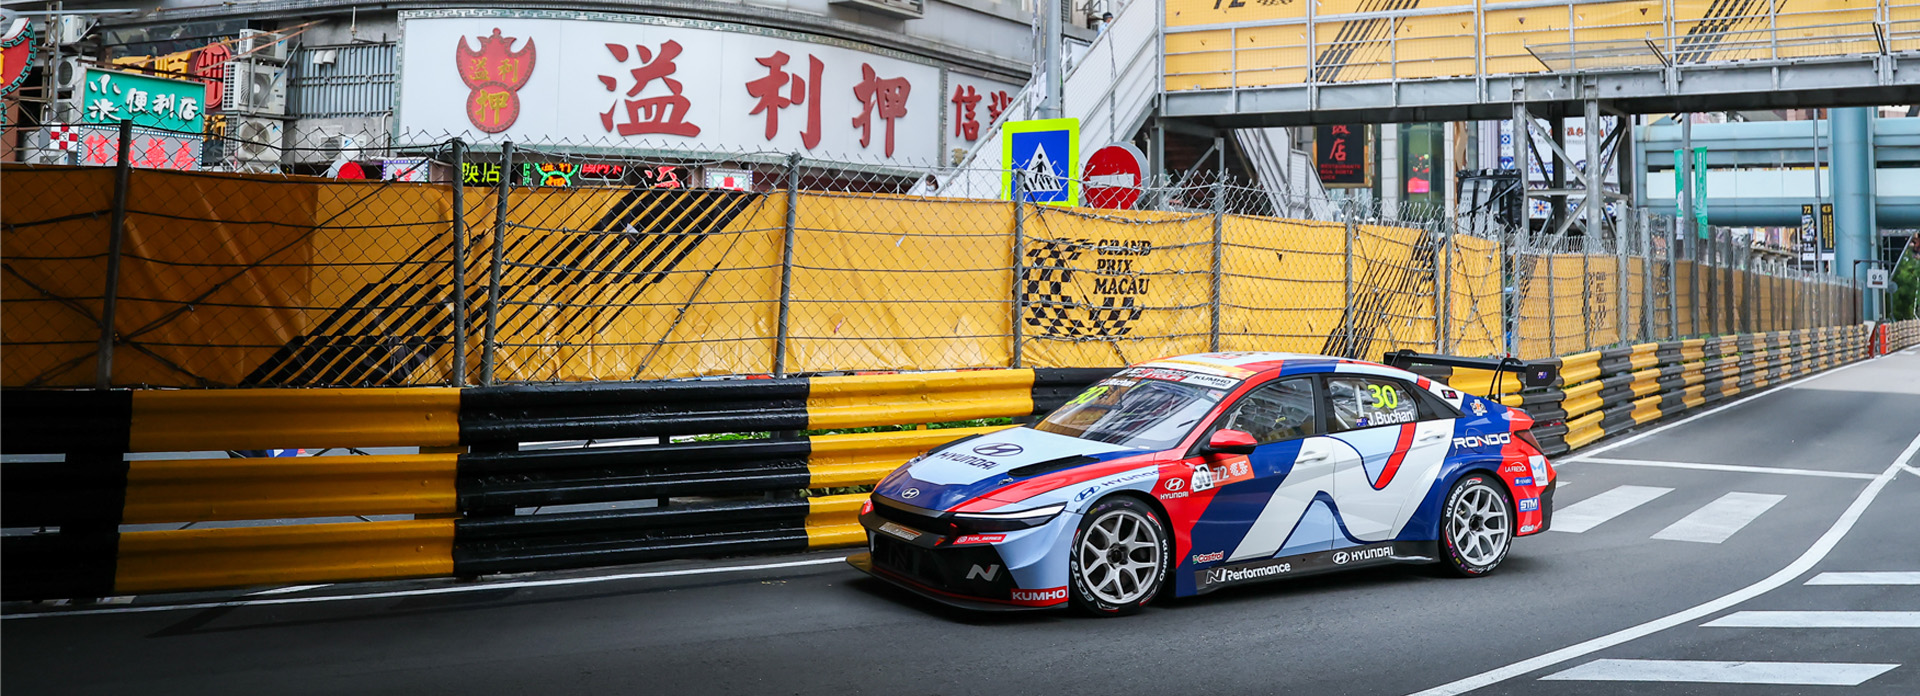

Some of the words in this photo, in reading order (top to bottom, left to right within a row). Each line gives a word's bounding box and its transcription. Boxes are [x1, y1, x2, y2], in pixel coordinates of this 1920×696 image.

[598, 39, 911, 158] 溢利押
[475, 89, 510, 124] 押
[1097, 239, 1151, 256] GRAND
[1097, 259, 1132, 275] PRIX
[1093, 278, 1150, 294] MACAU
[1193, 375, 1231, 384] KUMHO
[1367, 384, 1398, 409] 30
[1368, 411, 1414, 426] J.Buchan
[937, 452, 1000, 470] HYUNDAI
[1213, 467, 1230, 482] 72
[1160, 491, 1189, 500] HYUNDAI
[1520, 499, 1538, 509] STM
[1198, 551, 1224, 563] Castrol
[1351, 546, 1394, 561] HYUNDAI
[1227, 562, 1291, 581] Performance
[1012, 589, 1066, 601] KUMHO
